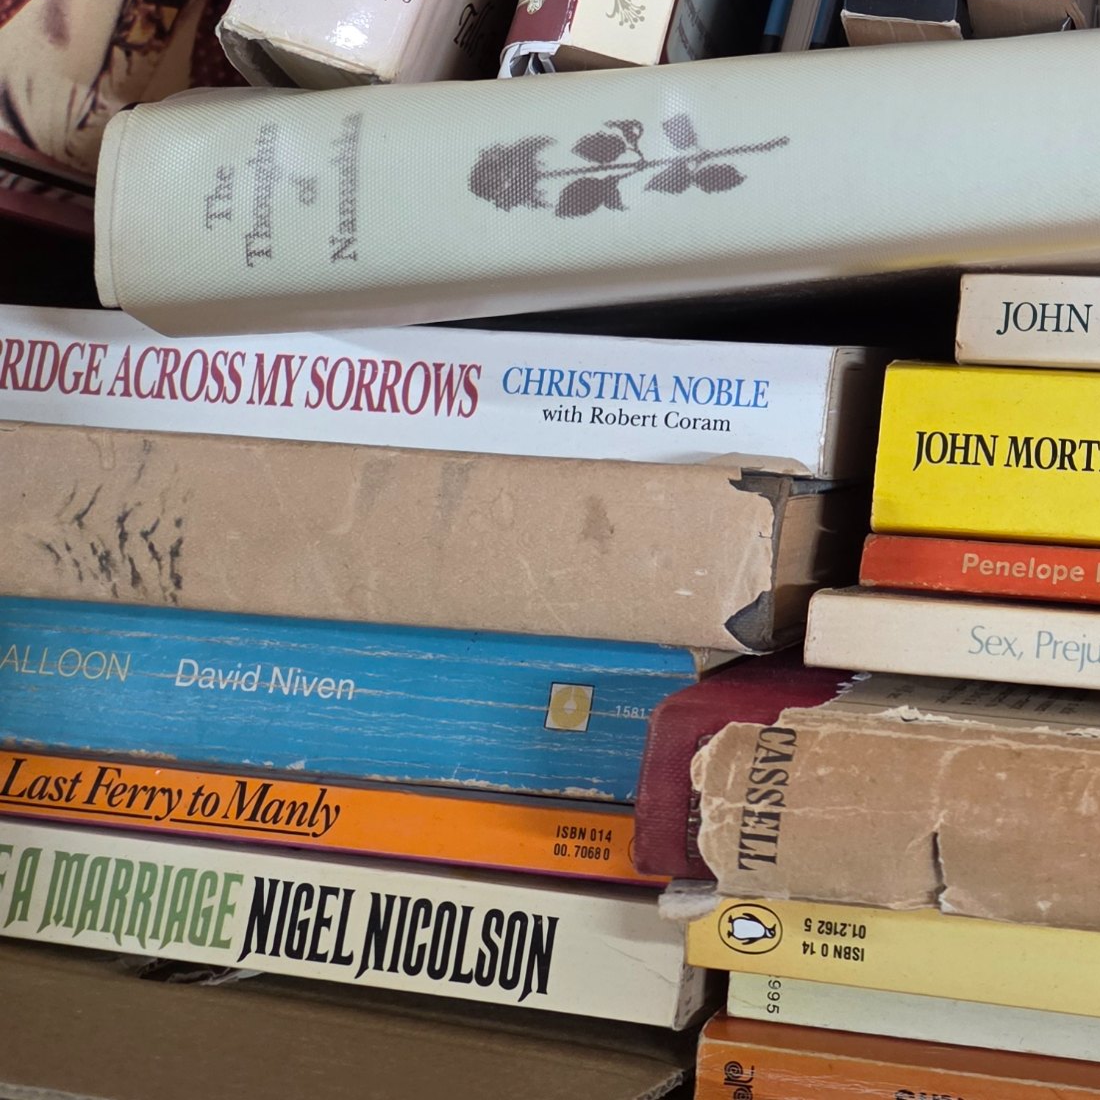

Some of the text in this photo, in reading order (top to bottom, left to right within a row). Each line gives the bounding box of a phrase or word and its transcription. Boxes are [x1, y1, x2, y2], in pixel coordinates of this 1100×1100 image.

[996, 301, 1093, 337] JOHN
[0, 338, 482, 418] RIDGE ACROSS MY SORROWS
[502, 366, 770, 409] CHRISTINA NOBLE
[542, 405, 731, 432] with Robert Coram
[913, 431, 999, 471] JOHN
[962, 554, 1085, 583] Penelope
[969, 625, 1025, 662] Sex,
[0, 643, 356, 701] ALLOON David Niven
[0, 757, 342, 839] Last Ferry to Manly
[738, 727, 797, 871] CASSELL
[556, 825, 587, 840] ISBN
[3, 847, 43, 929] A
[36, 850, 244, 950] MARRIAGE
[237, 876, 356, 966] NIGEL
[354, 892, 559, 1003] NICOLSON
[817, 920, 866, 939] 01.2162
[833, 944, 865, 962] ISBN
